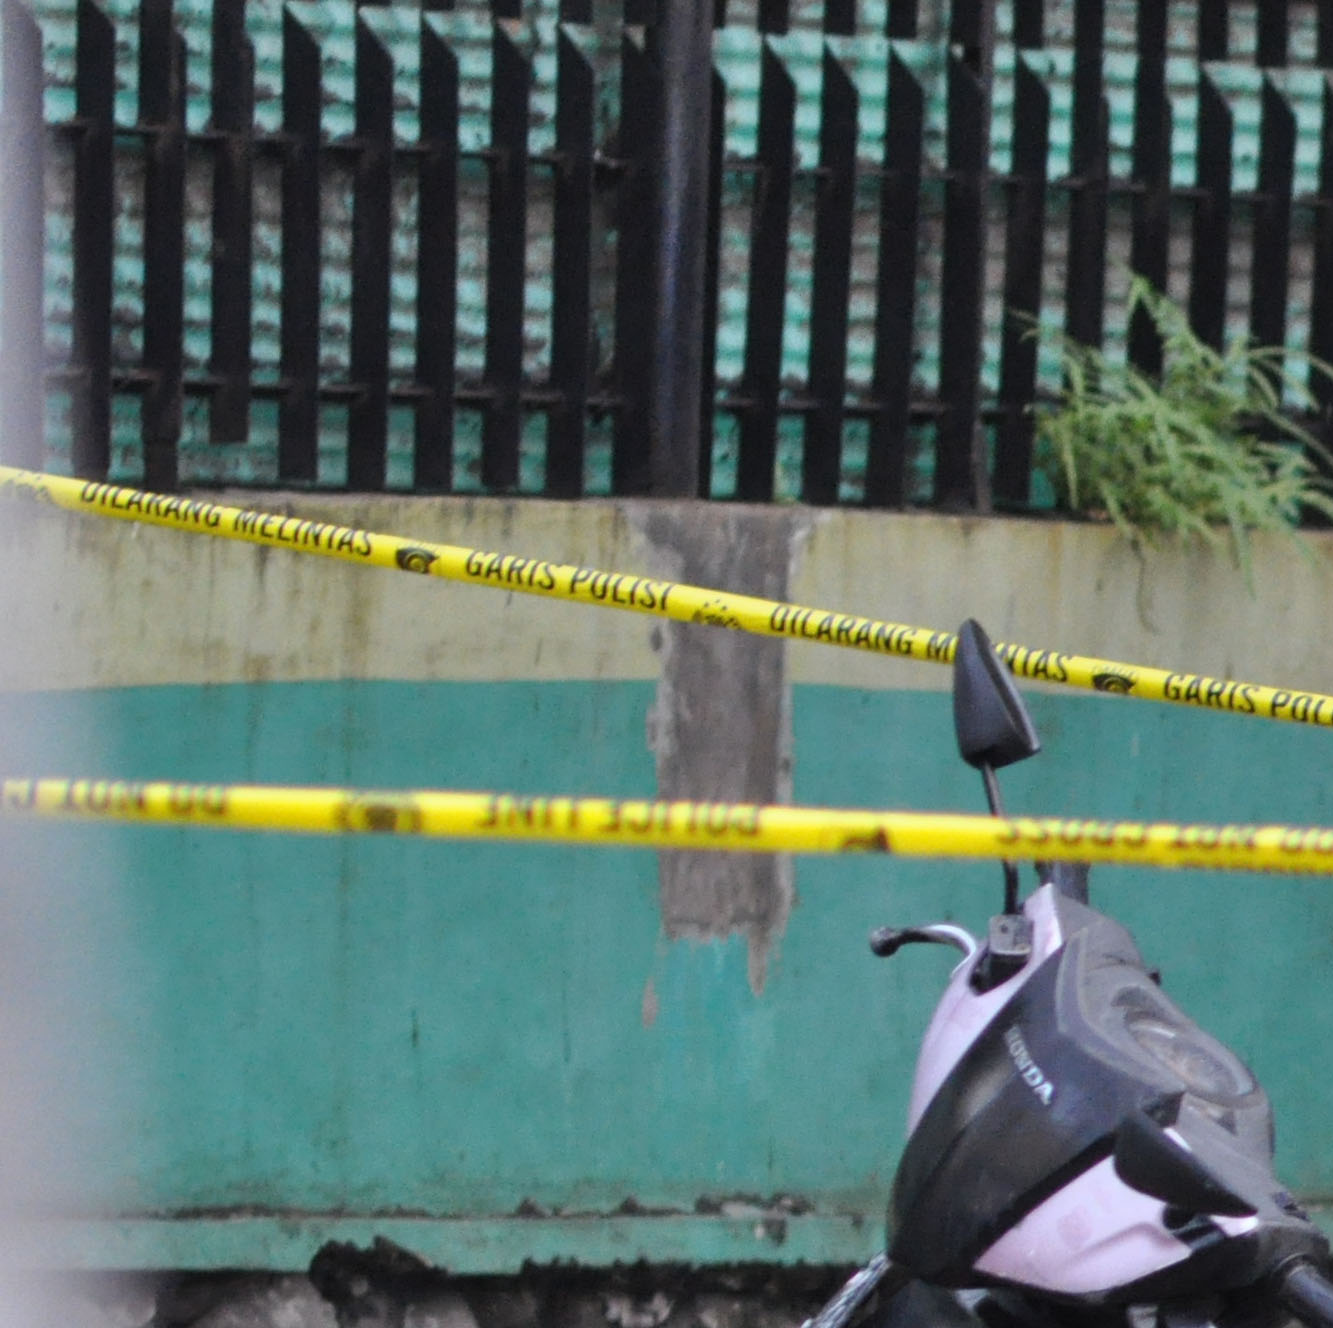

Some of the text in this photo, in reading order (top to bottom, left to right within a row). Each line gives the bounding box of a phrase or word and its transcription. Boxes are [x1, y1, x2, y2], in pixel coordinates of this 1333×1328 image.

[80, 483, 374, 557] DILARANG MELINTAS
[465, 549, 673, 611] GARIS POLISI
[771, 604, 917, 655] DILARANG
[1164, 671, 1259, 714] GARIS
[1004, 1024, 1053, 1106] HONDA
